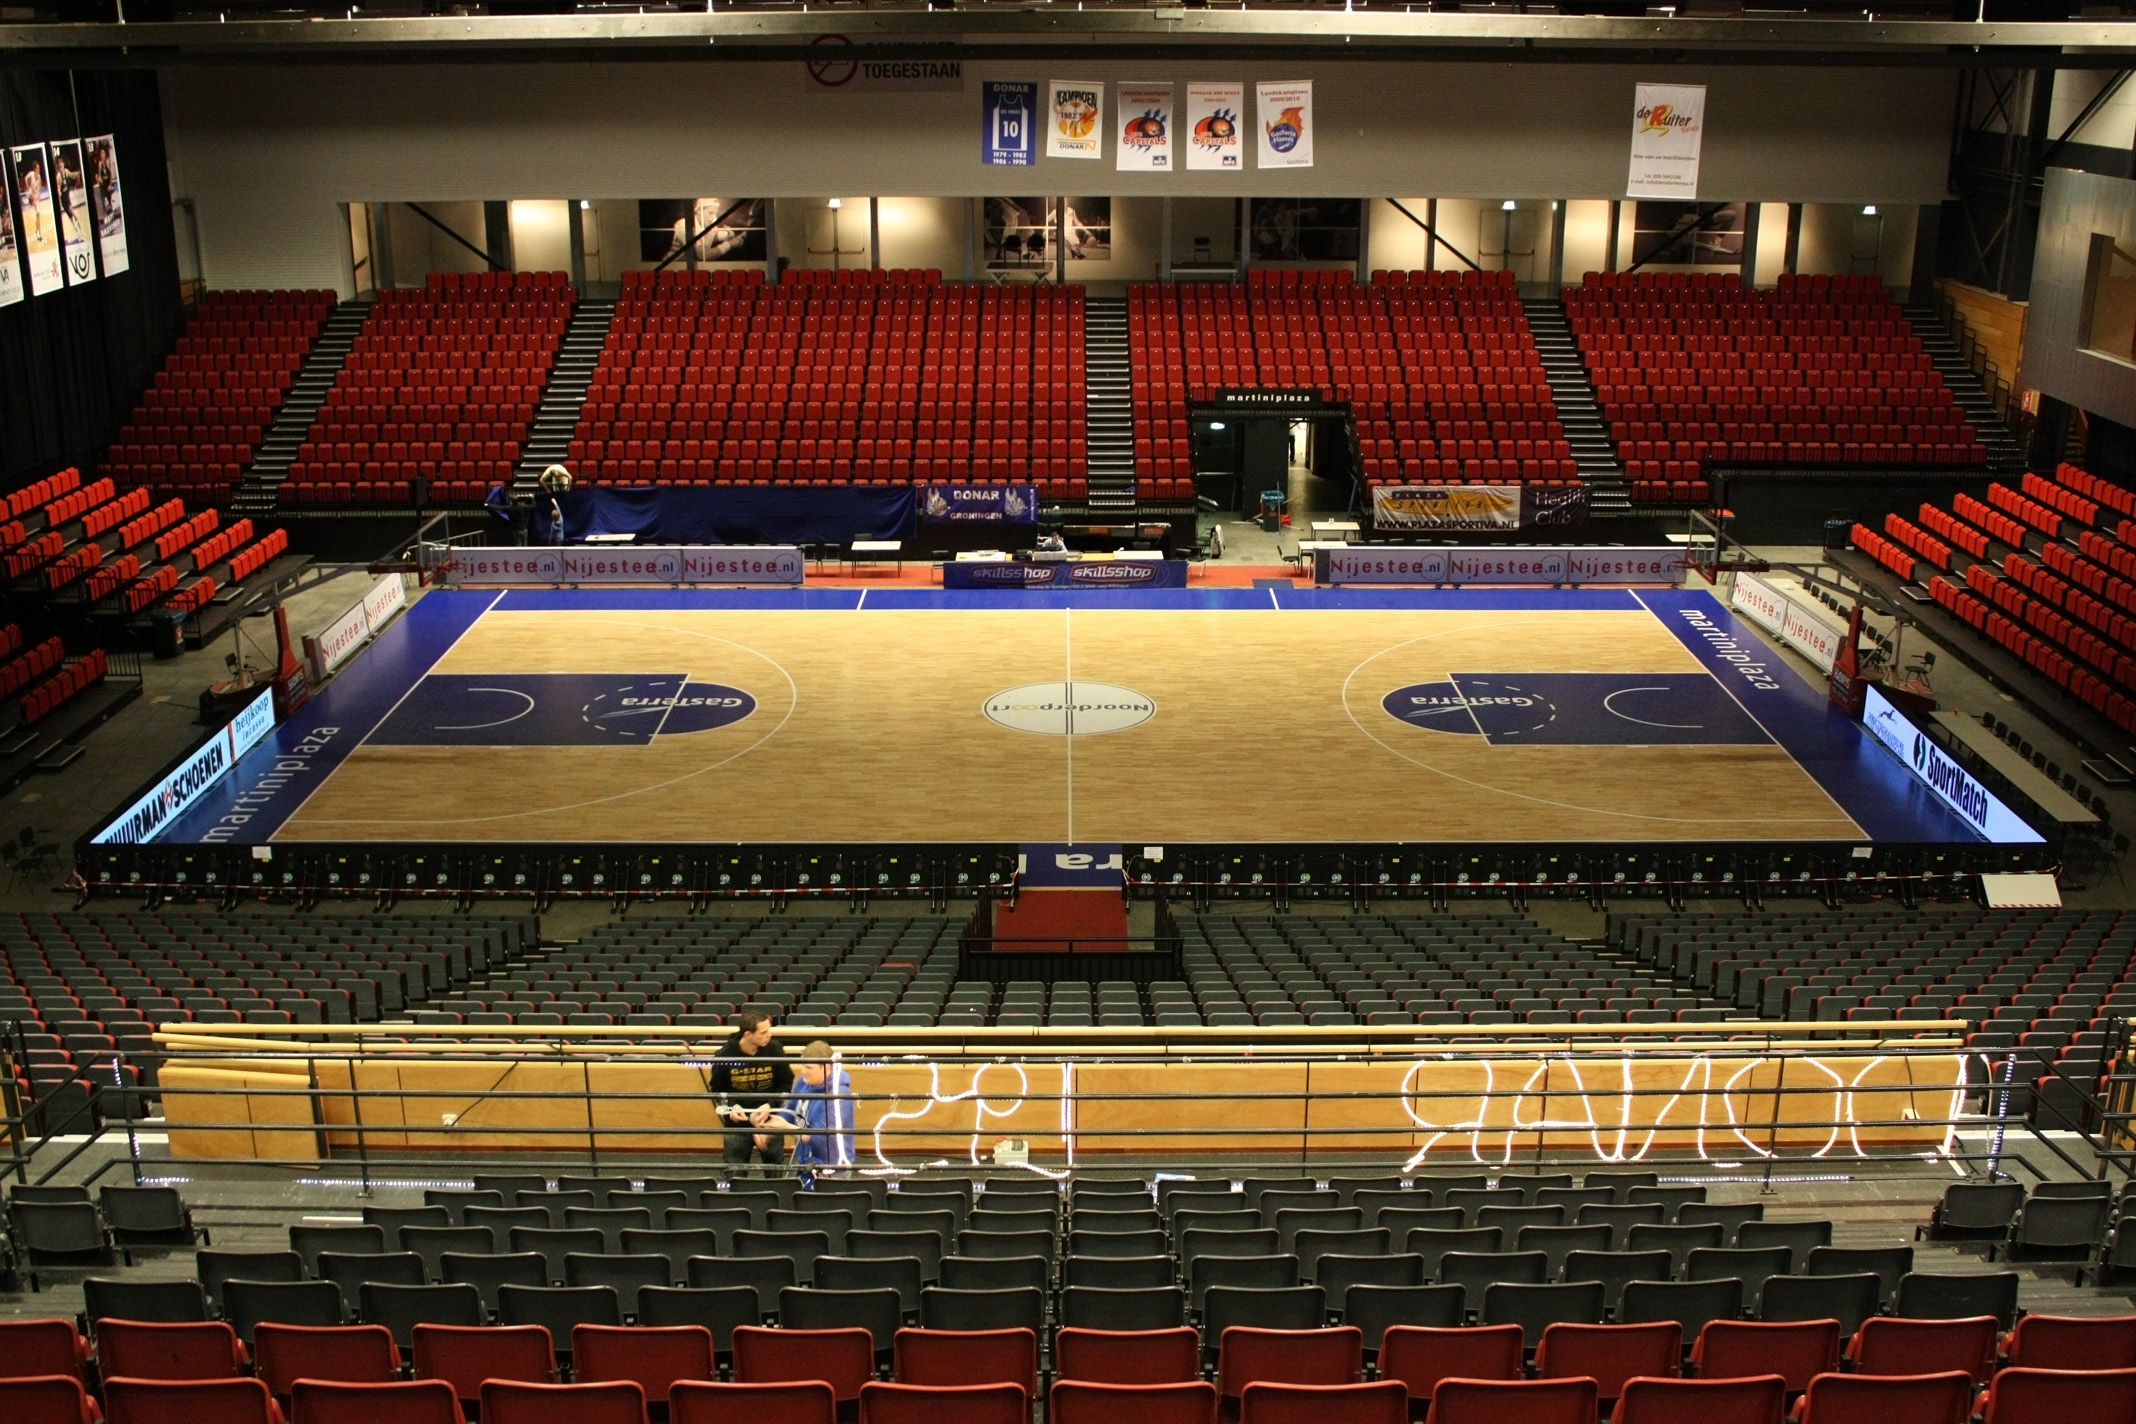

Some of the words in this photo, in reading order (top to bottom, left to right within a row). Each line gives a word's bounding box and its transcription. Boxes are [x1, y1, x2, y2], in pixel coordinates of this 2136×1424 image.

[863, 63, 961, 79] TOEGESTAAN
[993, 84, 1029, 93] DONAR
[1056, 90, 1097, 109] KAMPIOEN
[1002, 120, 1019, 138] 10
[1226, 394, 1310, 403] martiniplaza
[953, 489, 1000, 500] DONAR
[1536, 489, 1585, 506] Health
[949, 512, 1003, 520] GRONINGEN
[1535, 510, 1571, 525] Club
[1376, 520, 1517, 530] WWW.PLAZASPORTIVA.NL
[972, 567, 1052, 579] skillsshop
[1073, 565, 1152, 578] skillsshop
[1679, 609, 1780, 690] martiniplaza
[621, 697, 742, 708] GasTerra
[991, 703, 1149, 713] Noorderpoort
[1411, 696, 1533, 708] GasTerra
[235, 696, 269, 733] heijkoop
[172, 741, 224, 809] SCHOENEN
[199, 727, 341, 843] martiniplaza
[1927, 744, 1988, 829] SportMatch
